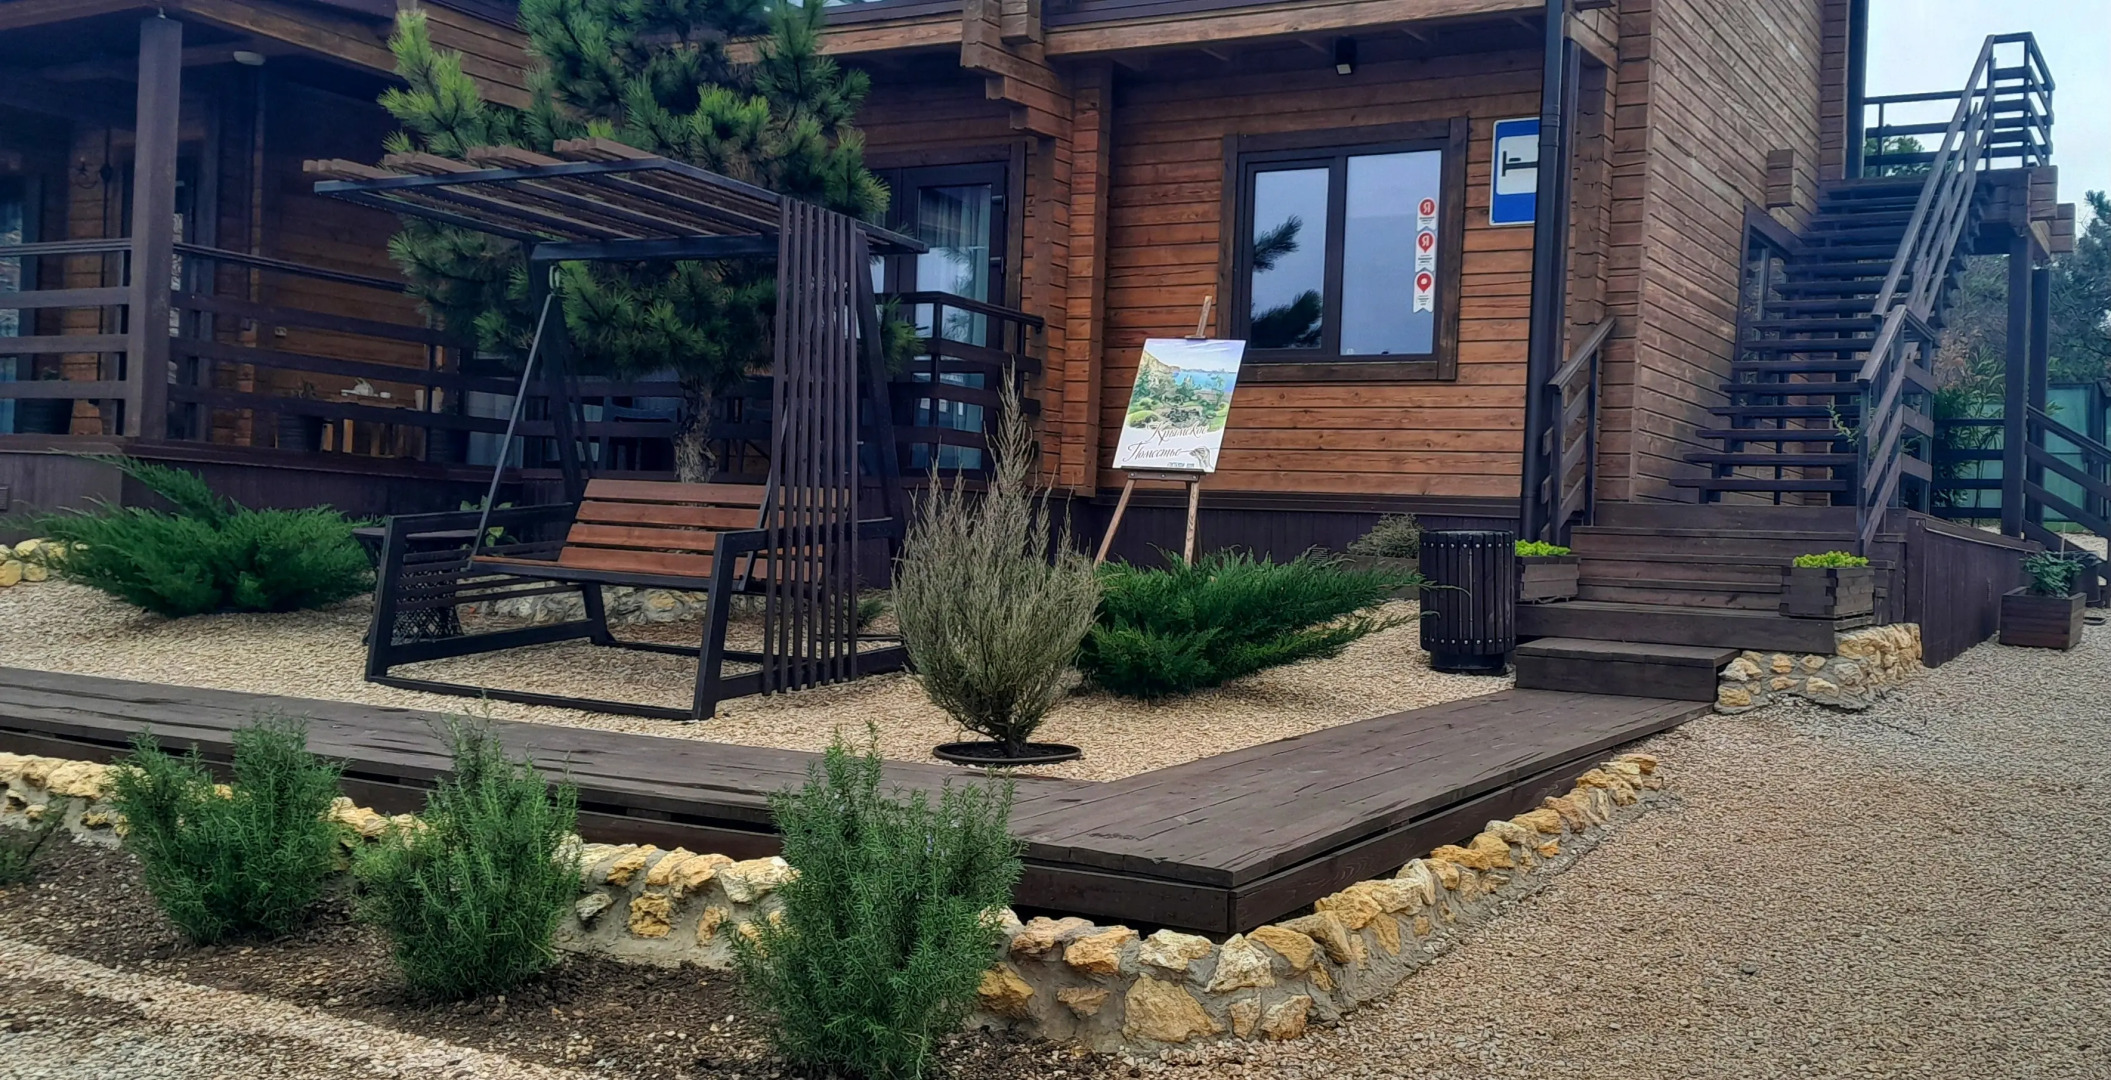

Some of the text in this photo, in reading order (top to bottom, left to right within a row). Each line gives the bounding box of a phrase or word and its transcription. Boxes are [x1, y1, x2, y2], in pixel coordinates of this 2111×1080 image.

[1423, 201, 1431, 213] Я
[1422, 235, 1430, 247] Я
[1146, 421, 1208, 445] Крымское
[1123, 441, 1181, 462] Поместье
